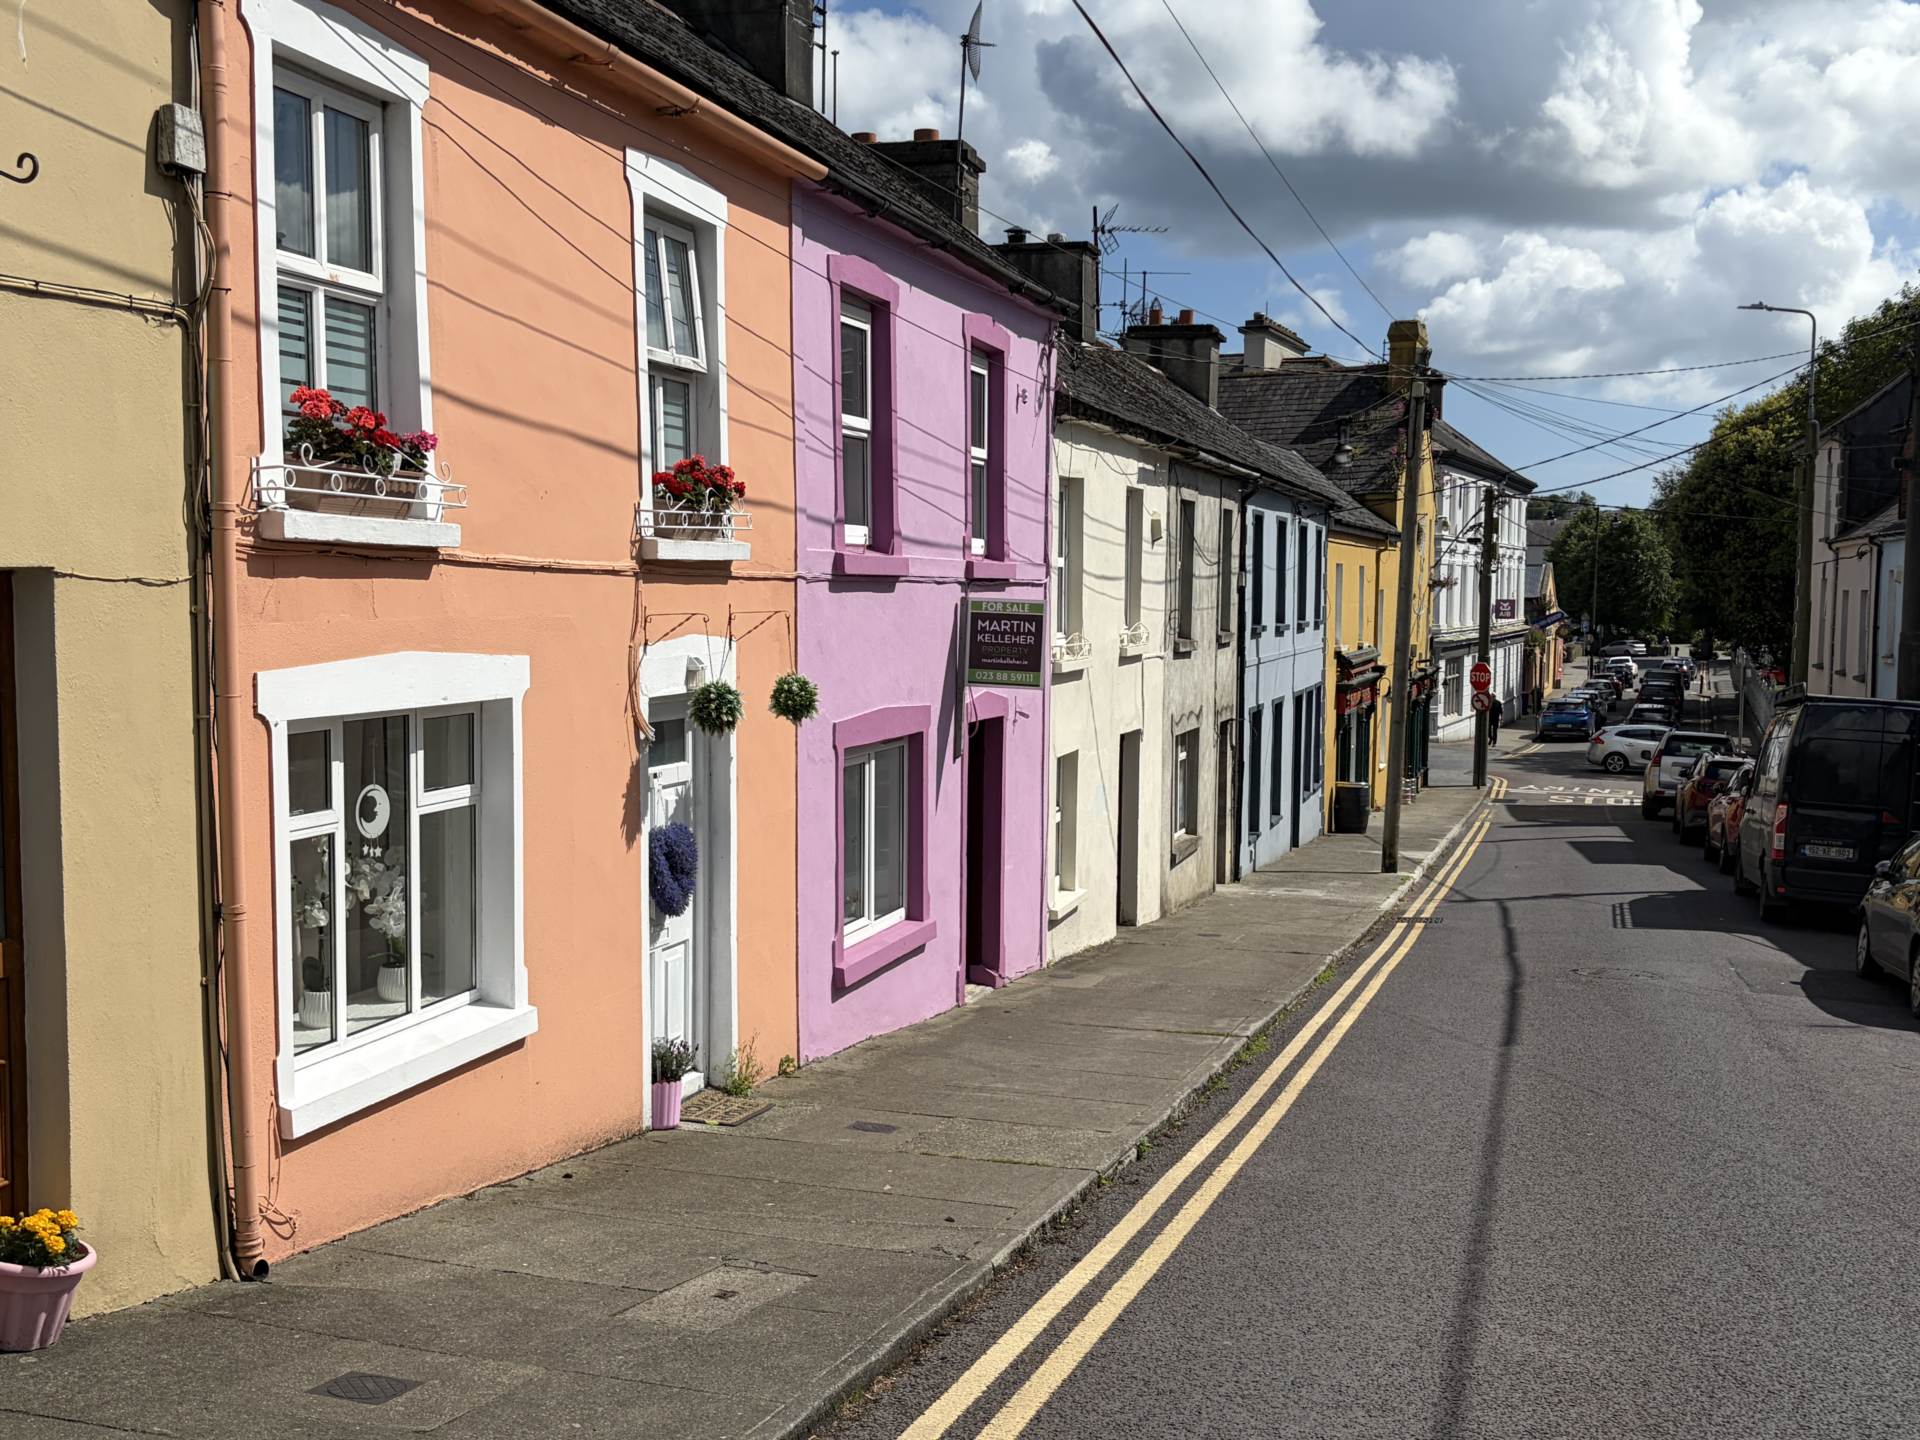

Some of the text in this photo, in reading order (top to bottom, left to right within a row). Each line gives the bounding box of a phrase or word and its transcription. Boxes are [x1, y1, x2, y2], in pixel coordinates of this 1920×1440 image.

[982, 602, 1030, 612] FOR SALE
[978, 619, 1036, 633] MARTIN
[977, 633, 1035, 645] KELLEHER
[982, 645, 1029, 654] PROPERTY
[975, 671, 1033, 682] 023 88 59111
[1471, 671, 1491, 683] STOP
